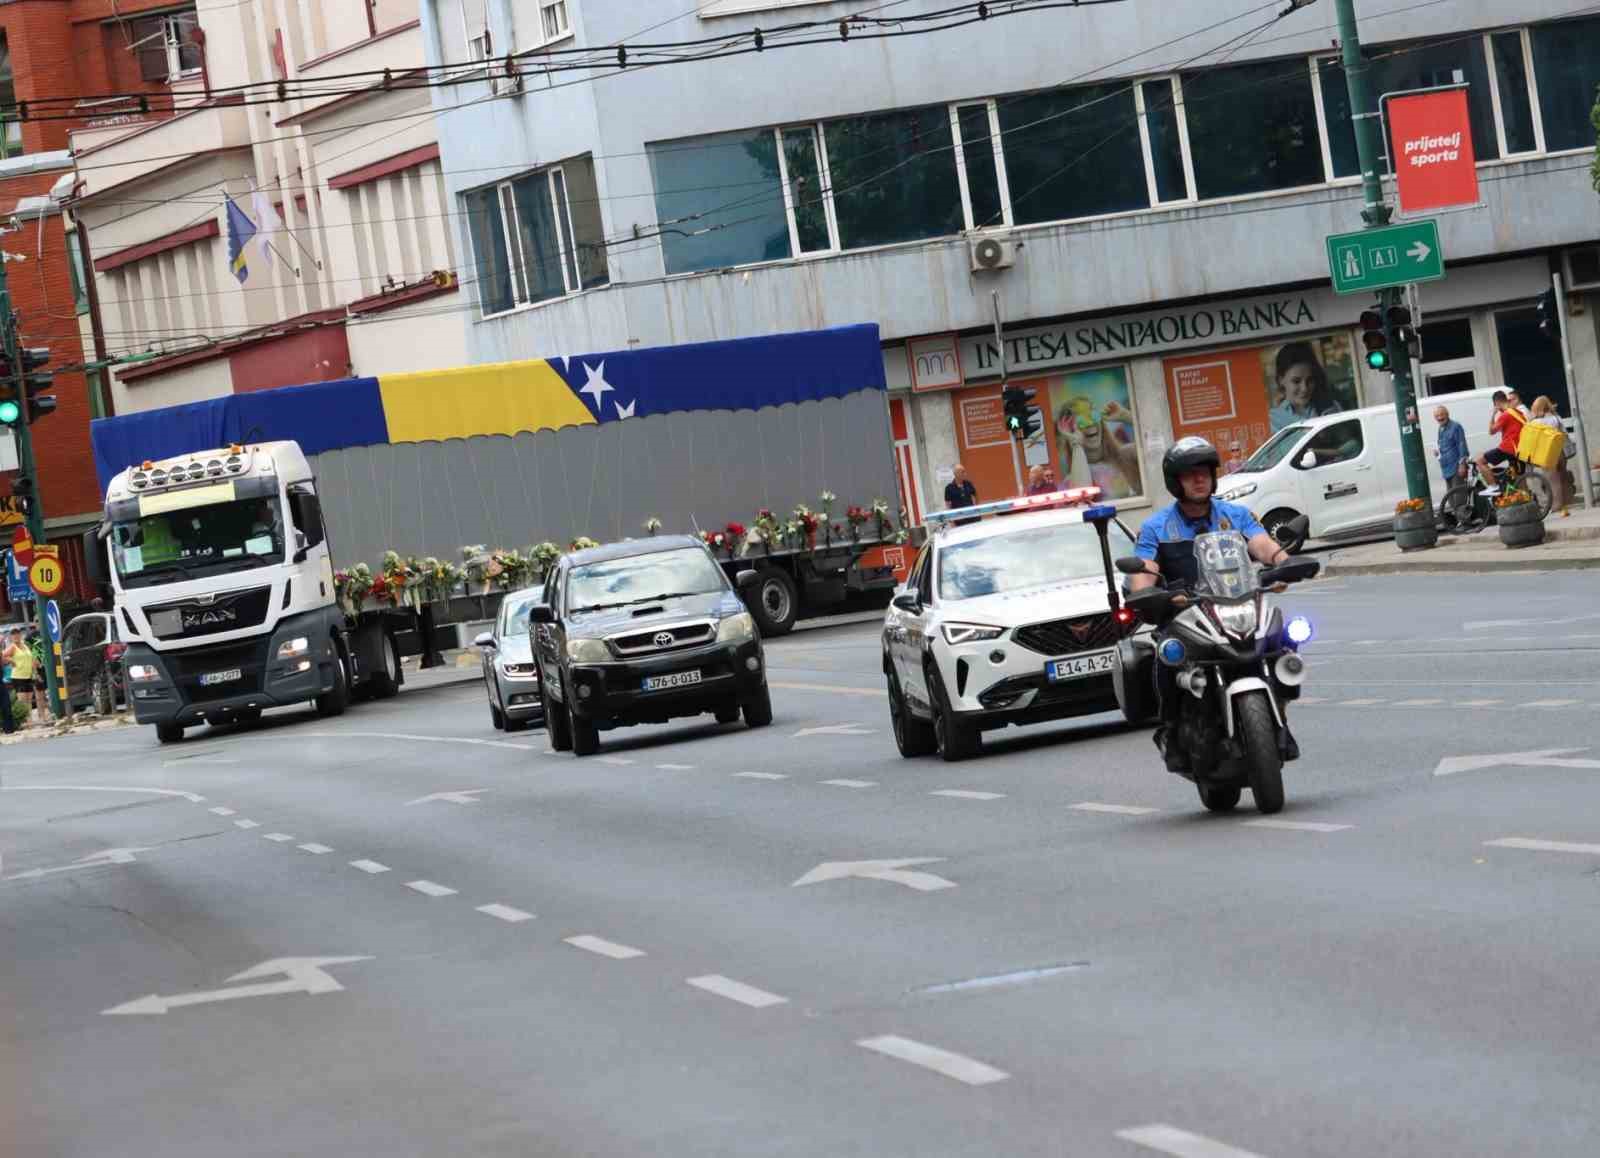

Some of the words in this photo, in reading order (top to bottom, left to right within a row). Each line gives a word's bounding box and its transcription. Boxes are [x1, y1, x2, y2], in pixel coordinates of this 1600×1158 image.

[1404, 132, 1461, 155] prijatelj
[1410, 150, 1459, 168] sporta
[1375, 248, 1394, 266] A1
[975, 331, 1072, 369] INTESA
[1075, 310, 1215, 356] SANPAOLO
[1218, 297, 1315, 336] BANKA
[40, 568, 53, 583] 10
